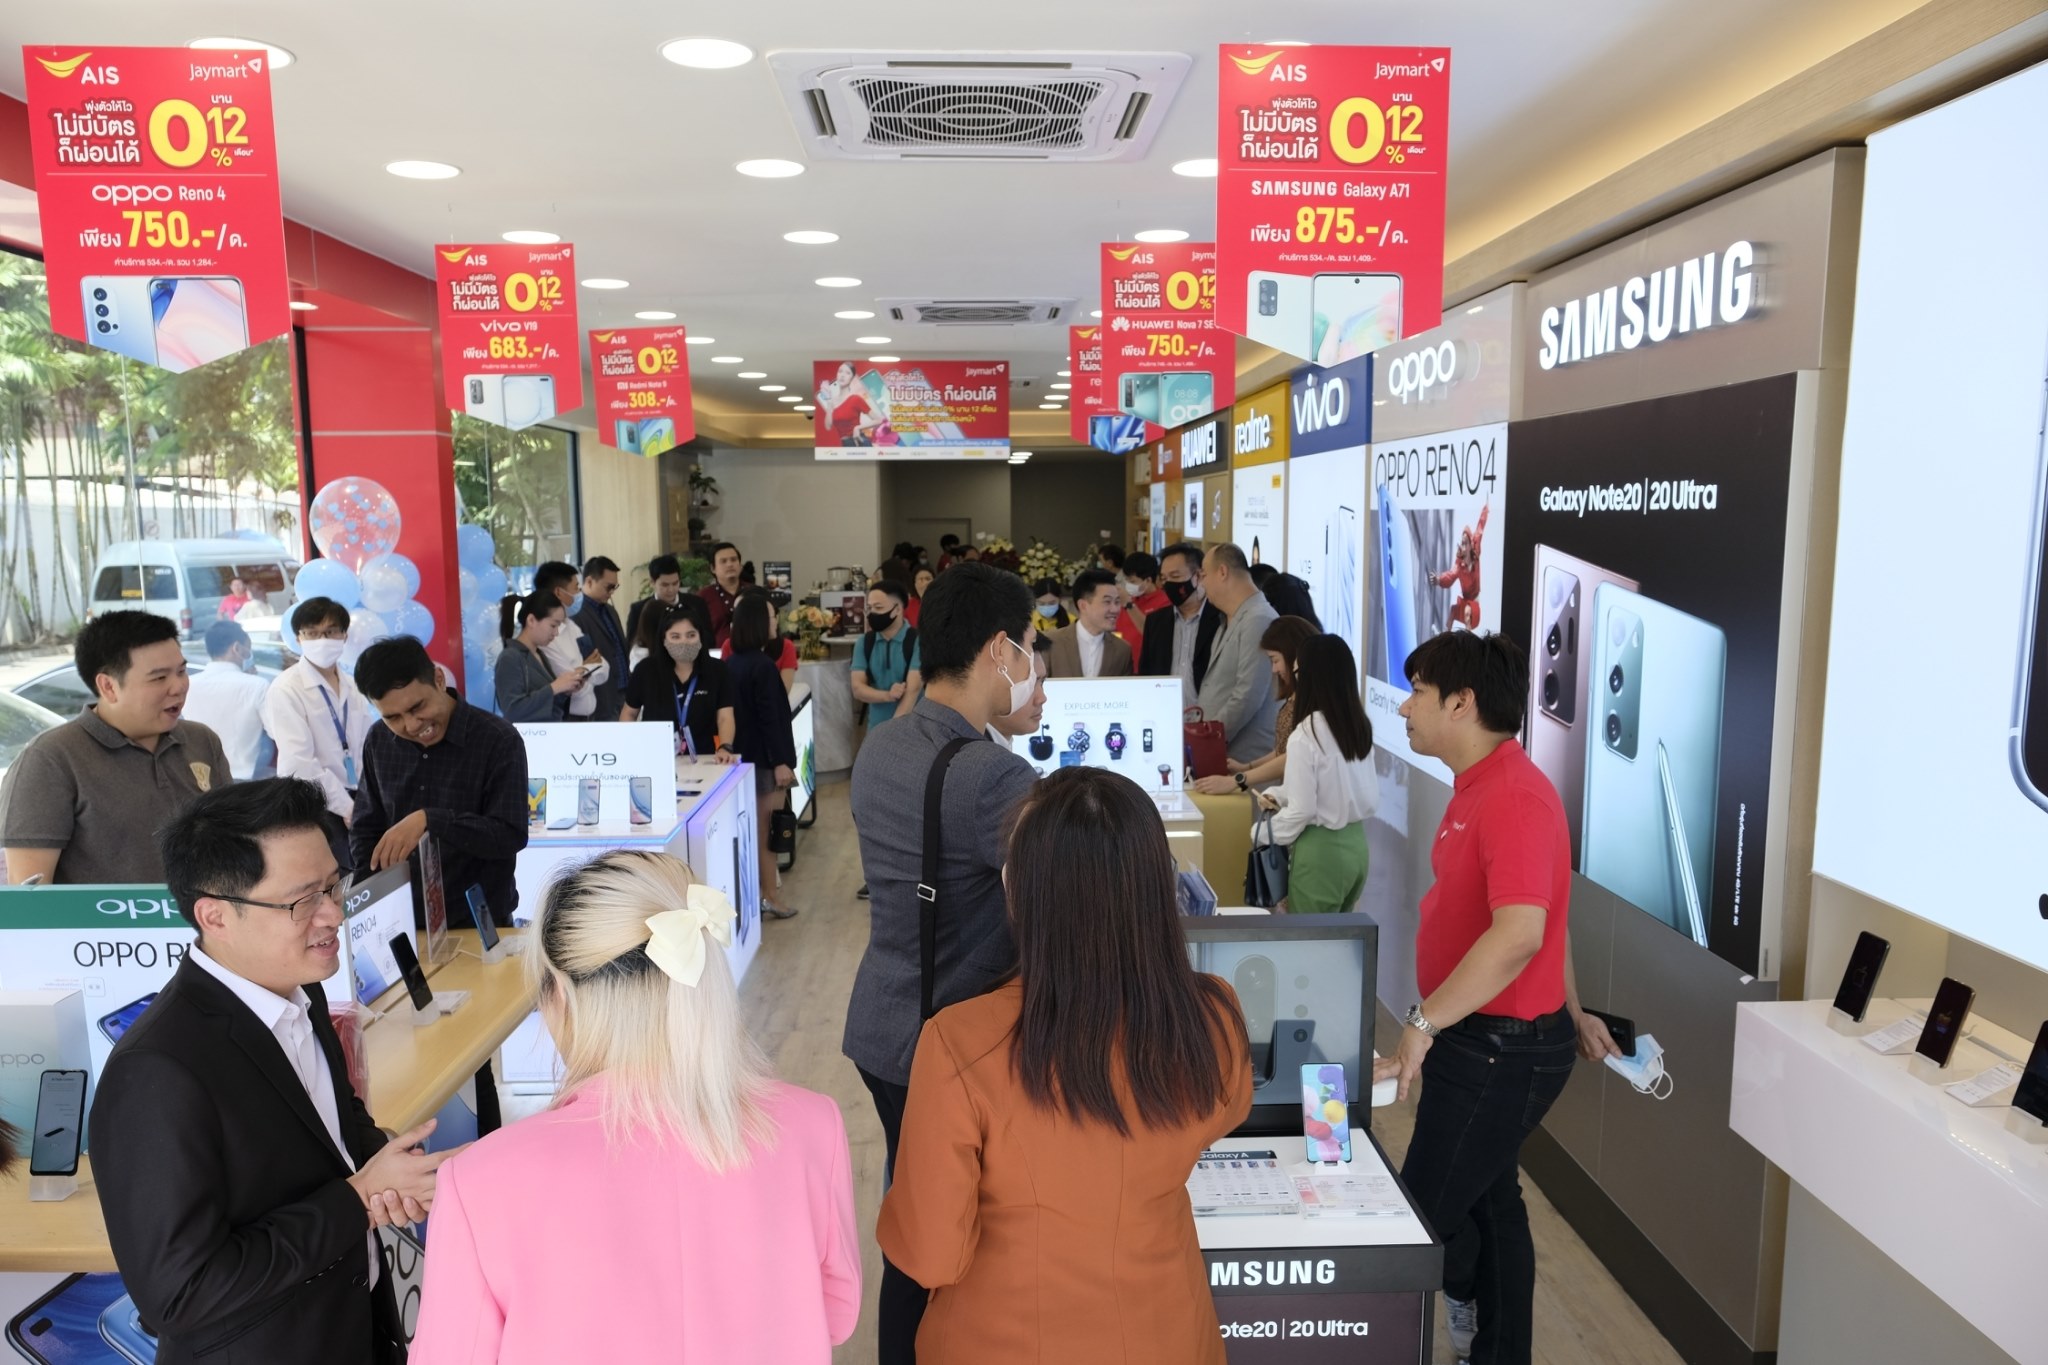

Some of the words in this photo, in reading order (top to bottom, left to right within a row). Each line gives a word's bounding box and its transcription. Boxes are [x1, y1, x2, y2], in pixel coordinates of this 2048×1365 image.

[81, 66, 119, 85] AIS
[189, 62, 248, 81] Jaymart
[1270, 64, 1307, 82] AIS
[1374, 62, 1430, 80] Jaymart
[210, 94, 233, 104] นาน
[1392, 93, 1413, 103] นาน
[54, 111, 136, 137] ไม่มีบัตร
[207, 106, 249, 144] 12
[1240, 110, 1318, 133] ไม่มีบัตร
[1329, 96, 1386, 164] 0
[1385, 105, 1424, 142] 12
[149, 98, 208, 168] 0
[58, 138, 141, 164] ก็ผ่อนได้
[1240, 135, 1318, 160] ก็ผ่อนได้
[91, 184, 173, 207] oppo
[179, 185, 214, 202] Reno
[216, 185, 226, 202] 4
[1251, 180, 1338, 197] SAMSUNG
[1343, 182, 1387, 201] Galaxy
[1389, 183, 1411, 198] A71
[79, 229, 122, 249] เพียง
[1250, 224, 1291, 243] เพียง
[465, 255, 488, 267] AIS
[1132, 253, 1154, 265] AIS
[451, 280, 498, 296] ไม่มีบัตร
[538, 276, 562, 299] 12
[1114, 279, 1160, 294] ไม่มีบัตร
[452, 296, 500, 311] ก็ผ่อนได้
[1539, 240, 1754, 371] SAMSUNG
[480, 319, 521, 332] vivo
[524, 321, 538, 331] V19
[1132, 320, 1174, 330] HUAWEI
[1177, 320, 1197, 330] Nova
[1197, 319, 1203, 329] 7
[611, 335, 628, 345] AIS
[463, 347, 488, 359] เพียง
[661, 348, 679, 364] 12
[1121, 345, 1146, 357] เพียง
[1388, 339, 1457, 404] oppo
[889, 385, 941, 401] ไม่มีบัตร
[943, 384, 997, 401] ก็ผ่อนได้
[1293, 373, 1344, 435] vivo
[1235, 408, 1270, 455] realme
[1181, 420, 1217, 470] HUAWEI
[1375, 447, 1420, 498] OPPO
[1425, 438, 1497, 497] RENO4
[1540, 485, 1588, 518] Galaxy
[1588, 482, 1642, 512] Note20
[1650, 482, 1671, 511] 20
[1672, 480, 1718, 511] Ultra
[1064, 702, 1101, 711] EXPLORE
[1103, 701, 1129, 710] MORE
[520, 728, 547, 736] vivo
[571, 753, 617, 766] V19
[96, 898, 180, 920] opp
[346, 889, 371, 912] po
[351, 915, 377, 942] RENO4
[74, 941, 158, 969] OPPO
[0, 1053, 45, 1068] ppo
[1210, 1258, 1336, 1286] MSUNG
[1219, 1320, 1278, 1339] ote20
[1289, 1321, 1314, 1339] 20
[1318, 1319, 1369, 1338] Ultra
